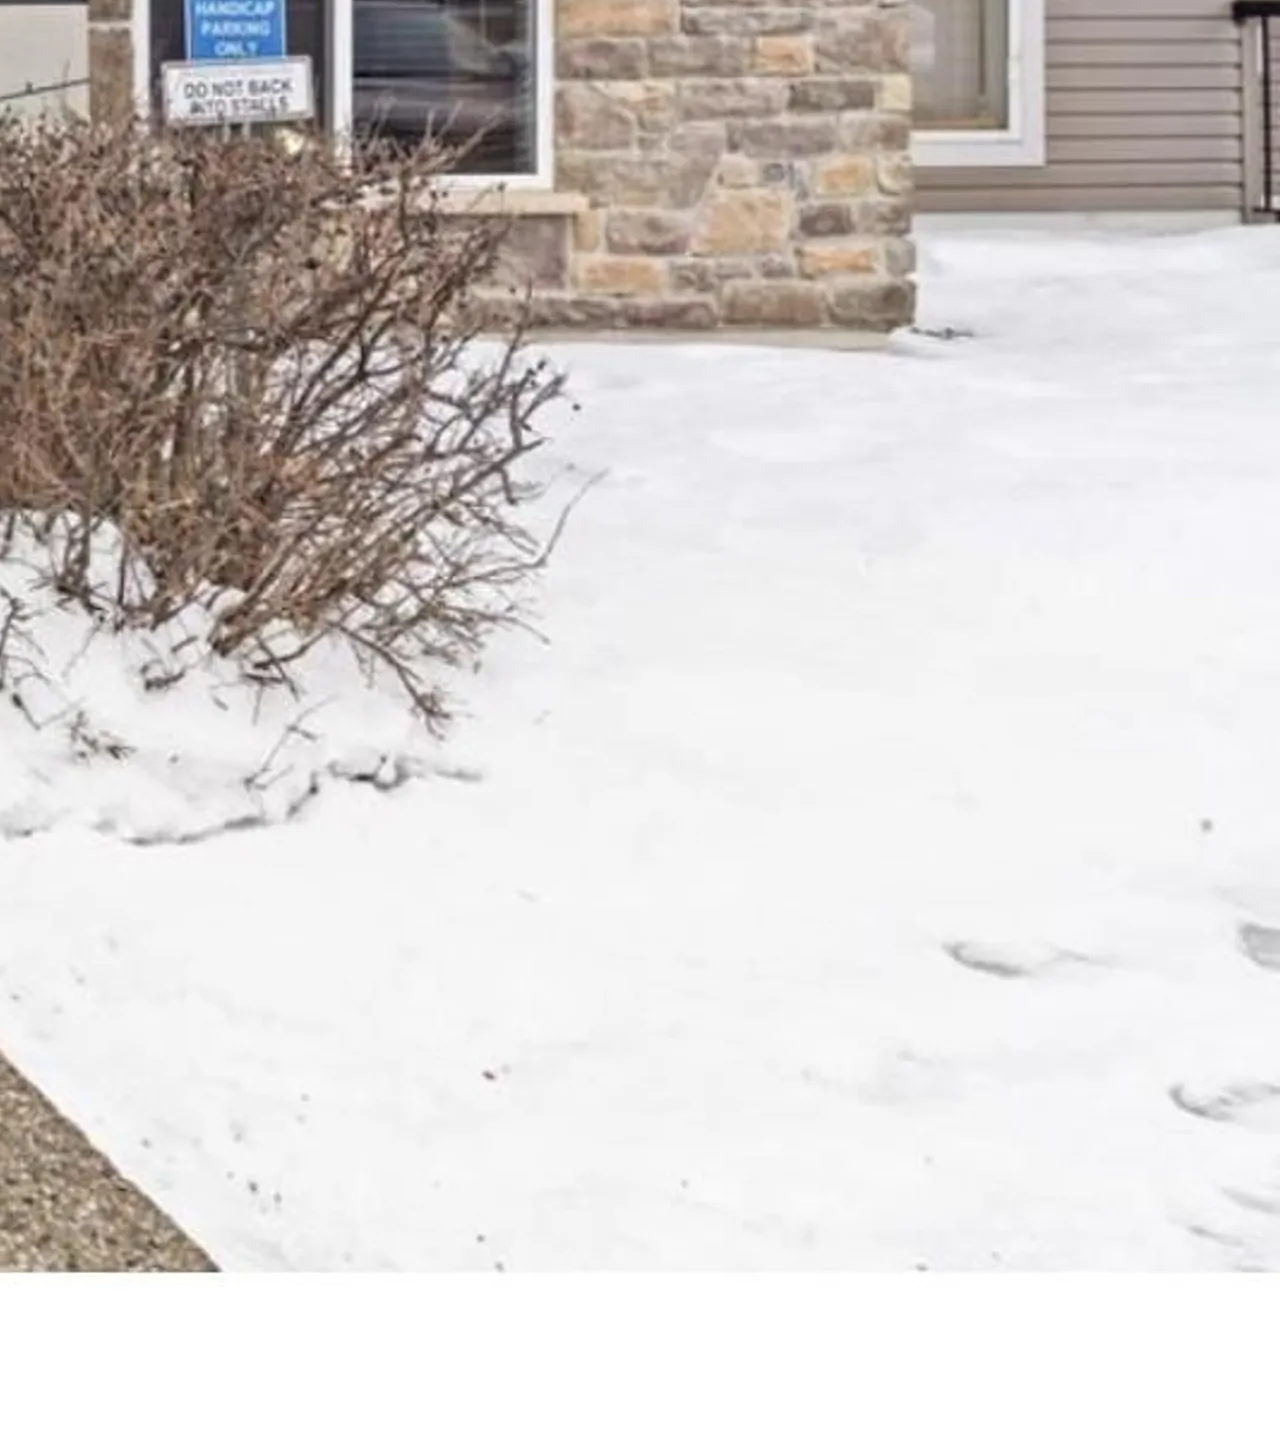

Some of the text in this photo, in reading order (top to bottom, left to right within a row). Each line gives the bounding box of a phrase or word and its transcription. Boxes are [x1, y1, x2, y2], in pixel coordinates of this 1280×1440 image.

[196, 1, 275, 16] HANDICAP
[201, 20, 271, 36] PARKING
[214, 42, 257, 55] ONLY
[183, 79, 292, 99] DO NOT BACK
